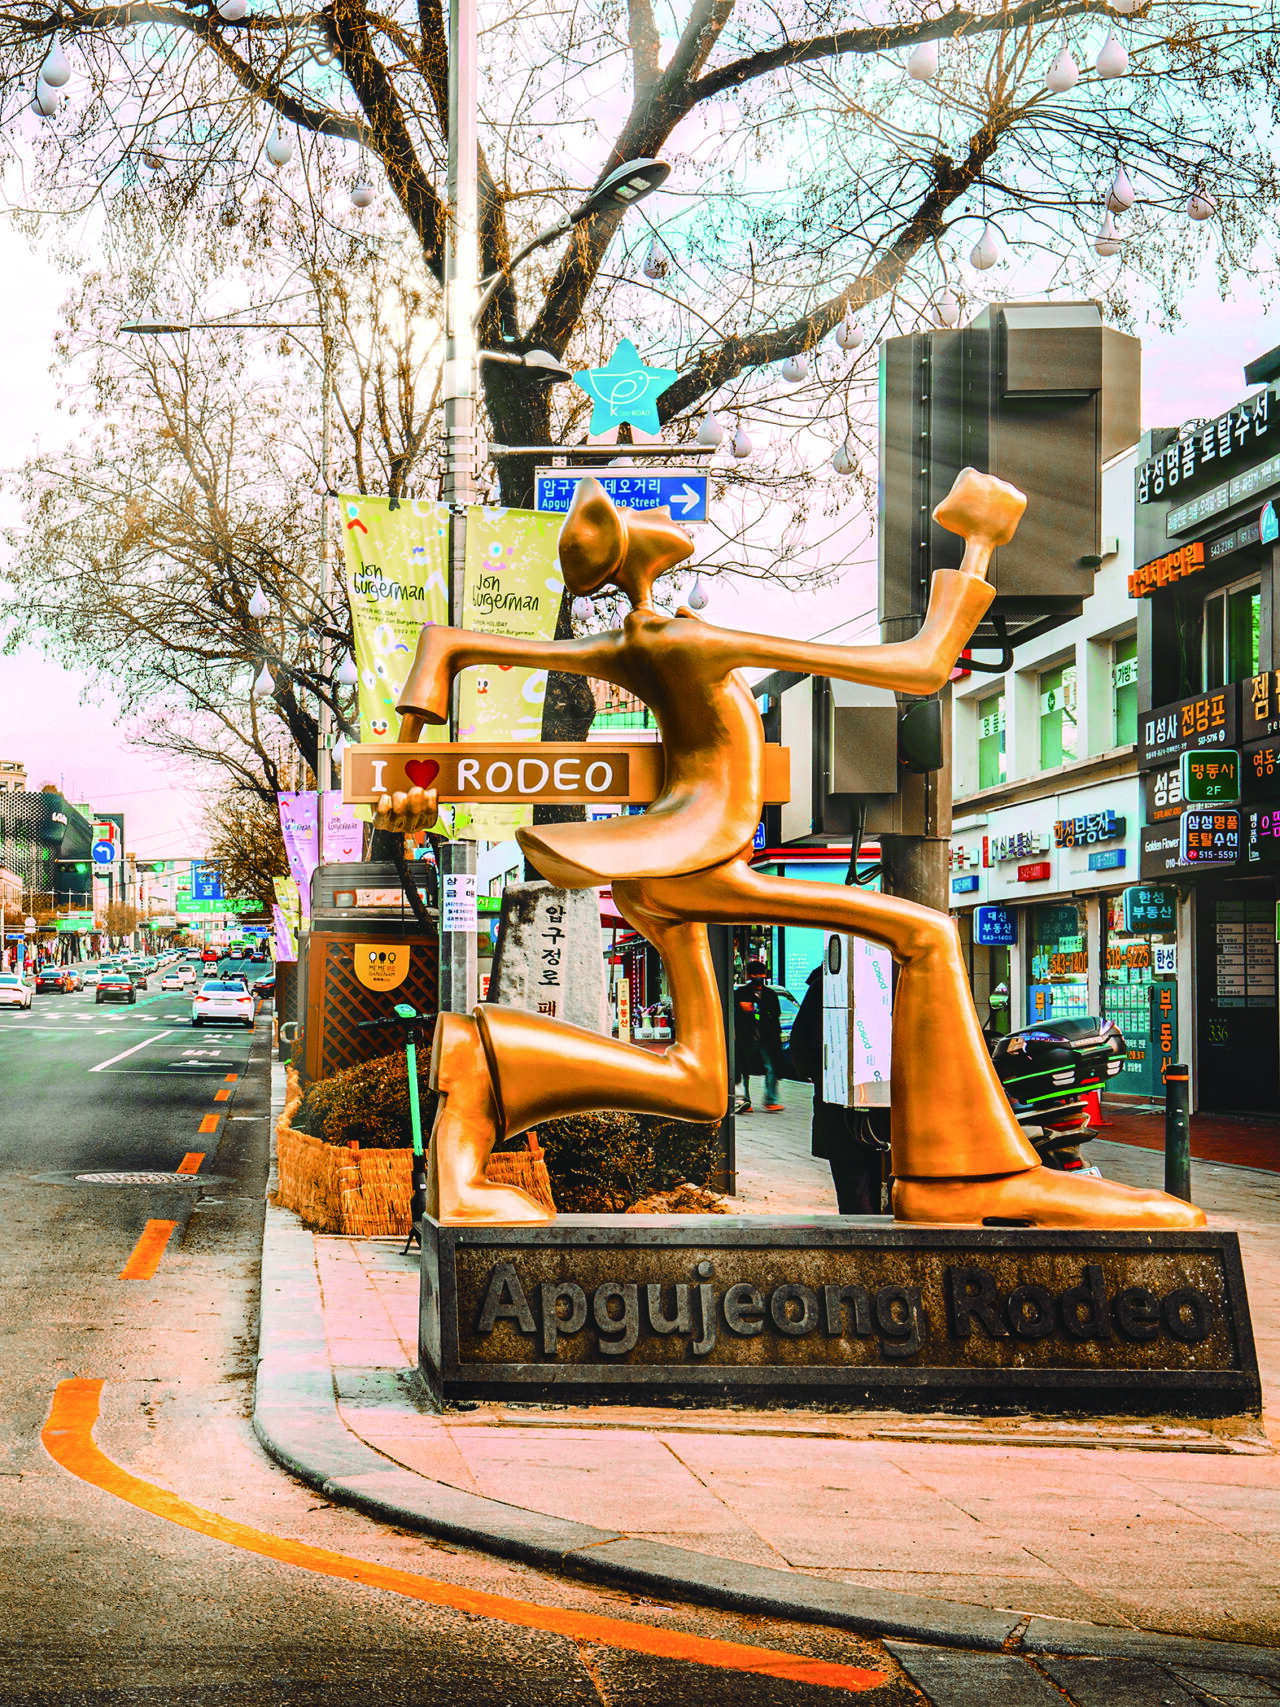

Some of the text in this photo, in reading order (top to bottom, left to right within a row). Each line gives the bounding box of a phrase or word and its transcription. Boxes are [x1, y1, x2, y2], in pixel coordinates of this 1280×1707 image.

[543, 479, 661, 497] 압구데오거리
[630, 497, 660, 508] Street
[359, 561, 383, 580] Jon
[354, 572, 425, 603] burgerman
[476, 574, 500, 592] Jon
[1145, 694, 1225, 746] 대성사 전당포
[371, 758, 613, 794] I RODEO
[1191, 764, 1234, 780] 명동사
[1206, 785, 1221, 796] 2F
[1053, 810, 1112, 849] 한성부동산
[1188, 815, 1238, 830] 삼성명품
[1145, 839, 1162, 853] Golden
[1188, 832, 1238, 847] 토탈수선
[1198, 850, 1238, 858] 515-5591
[1138, 891, 1165, 904] 한성
[987, 911, 1007, 922] 대신
[1132, 905, 1172, 919] 부동산
[982, 923, 1012, 934] 부동산
[538, 904, 566, 987] 압구정로
[1051, 951, 1088, 975] 543-1400
[1106, 944, 1149, 970] 518-5225
[1156, 951, 1174, 970] 한성
[476, 1260, 1213, 1357] Apgujeong Rodeo
